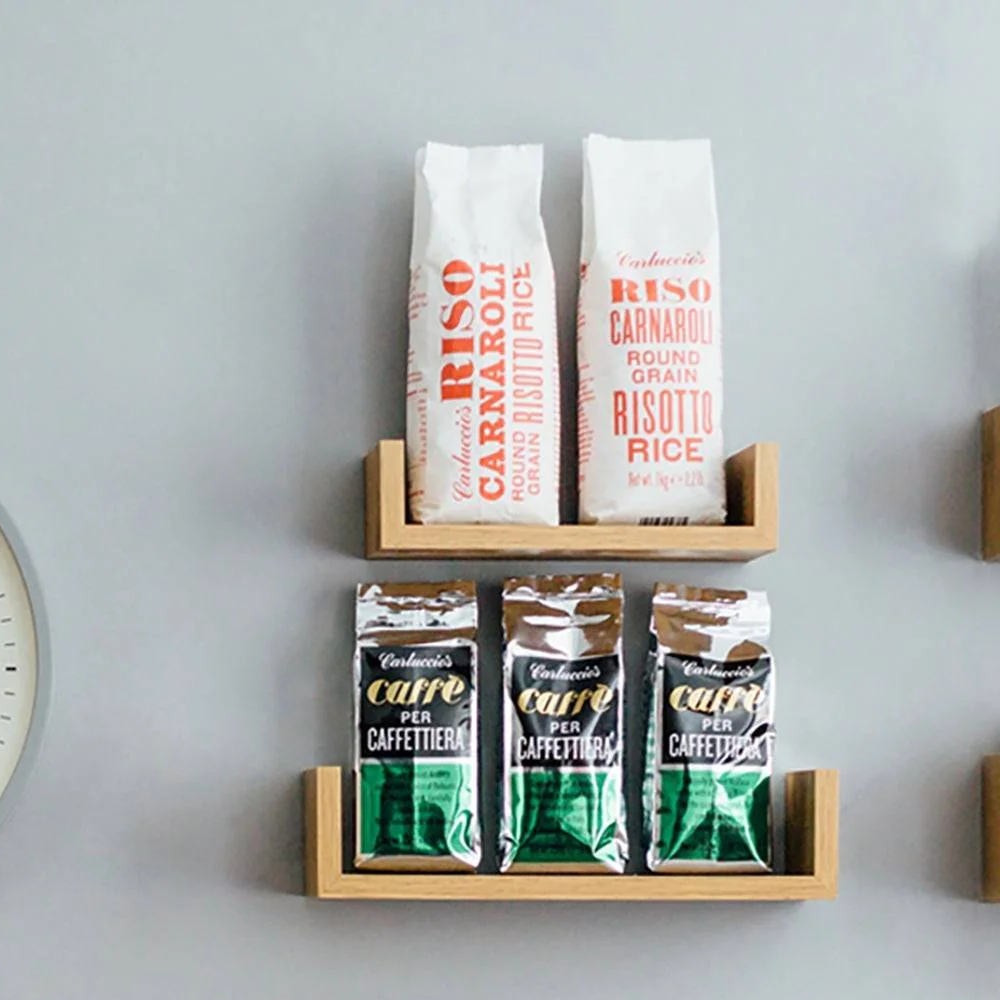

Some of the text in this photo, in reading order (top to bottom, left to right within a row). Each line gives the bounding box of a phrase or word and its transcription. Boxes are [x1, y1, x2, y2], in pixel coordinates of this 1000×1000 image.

[512, 261, 534, 332] RICE
[609, 277, 712, 304] RISO
[440, 258, 475, 401] RISO
[609, 307, 713, 346] CARNAROLI
[626, 350, 701, 366] ROUND
[479, 262, 506, 501] CARNAROLI
[512, 337, 544, 425] RISOTTO
[631, 368, 697, 384] GRAIN
[613, 390, 713, 436] RISOTTO
[527, 432, 541, 497] GRAIN
[627, 438, 704, 464] RICE
[512, 430, 526, 502] ROUND
[379, 653, 453, 669] Carluccio's
[530, 663, 601, 681] Carluccio's
[682, 660, 754, 678] Carluccio's
[366, 675, 465, 706] caffè
[517, 683, 614, 717] caffè
[401, 711, 432, 724] PER
[550, 721, 580, 734] PER
[702, 719, 732, 732] PER
[367, 726, 465, 751] CAFFETTIERA
